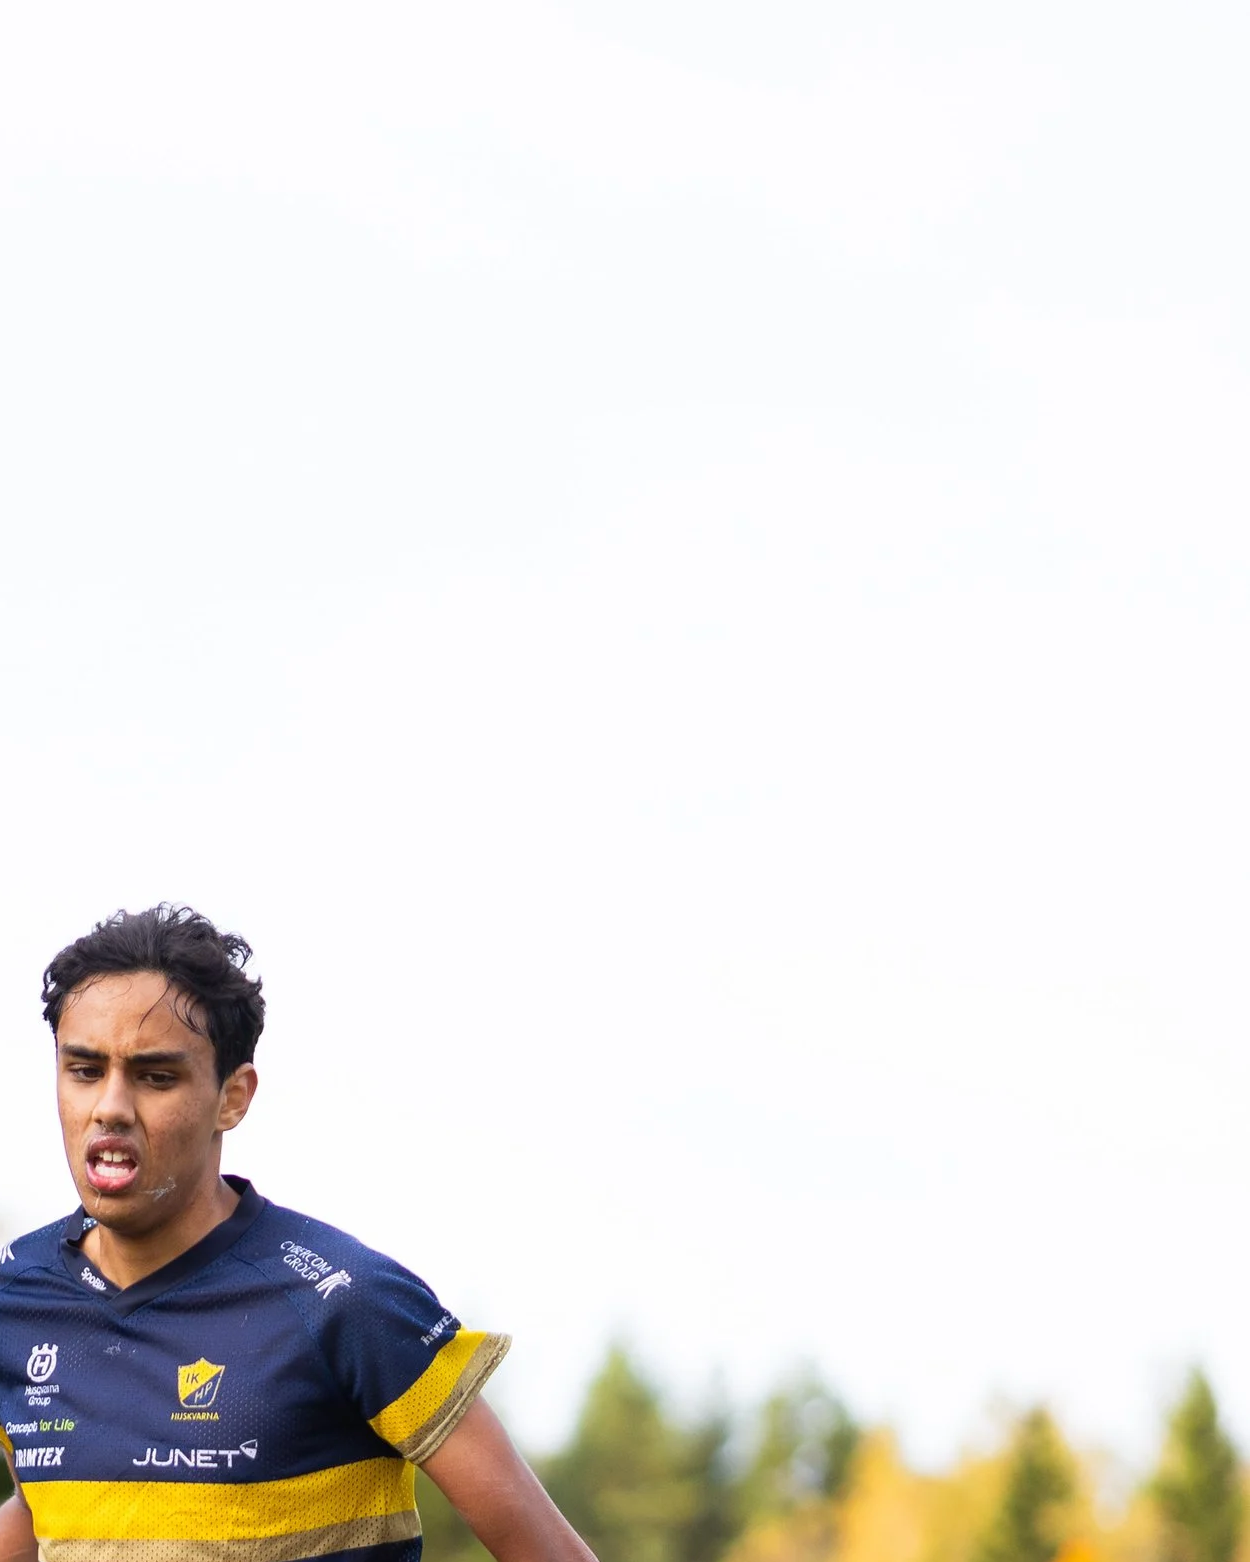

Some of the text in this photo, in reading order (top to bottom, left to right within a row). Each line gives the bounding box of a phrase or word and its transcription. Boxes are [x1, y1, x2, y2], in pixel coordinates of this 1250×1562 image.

[280, 1240, 332, 1275] CYBERCOM
[283, 1253, 320, 1281] GROUP
[186, 1373, 200, 1384] IK
[28, 1396, 51, 1406] Group
[194, 1381, 213, 1403] HP
[170, 1411, 220, 1421] HUSKVARNA
[5, 1418, 75, 1436] Concept for Life
[132, 1447, 240, 1468] JUNET
